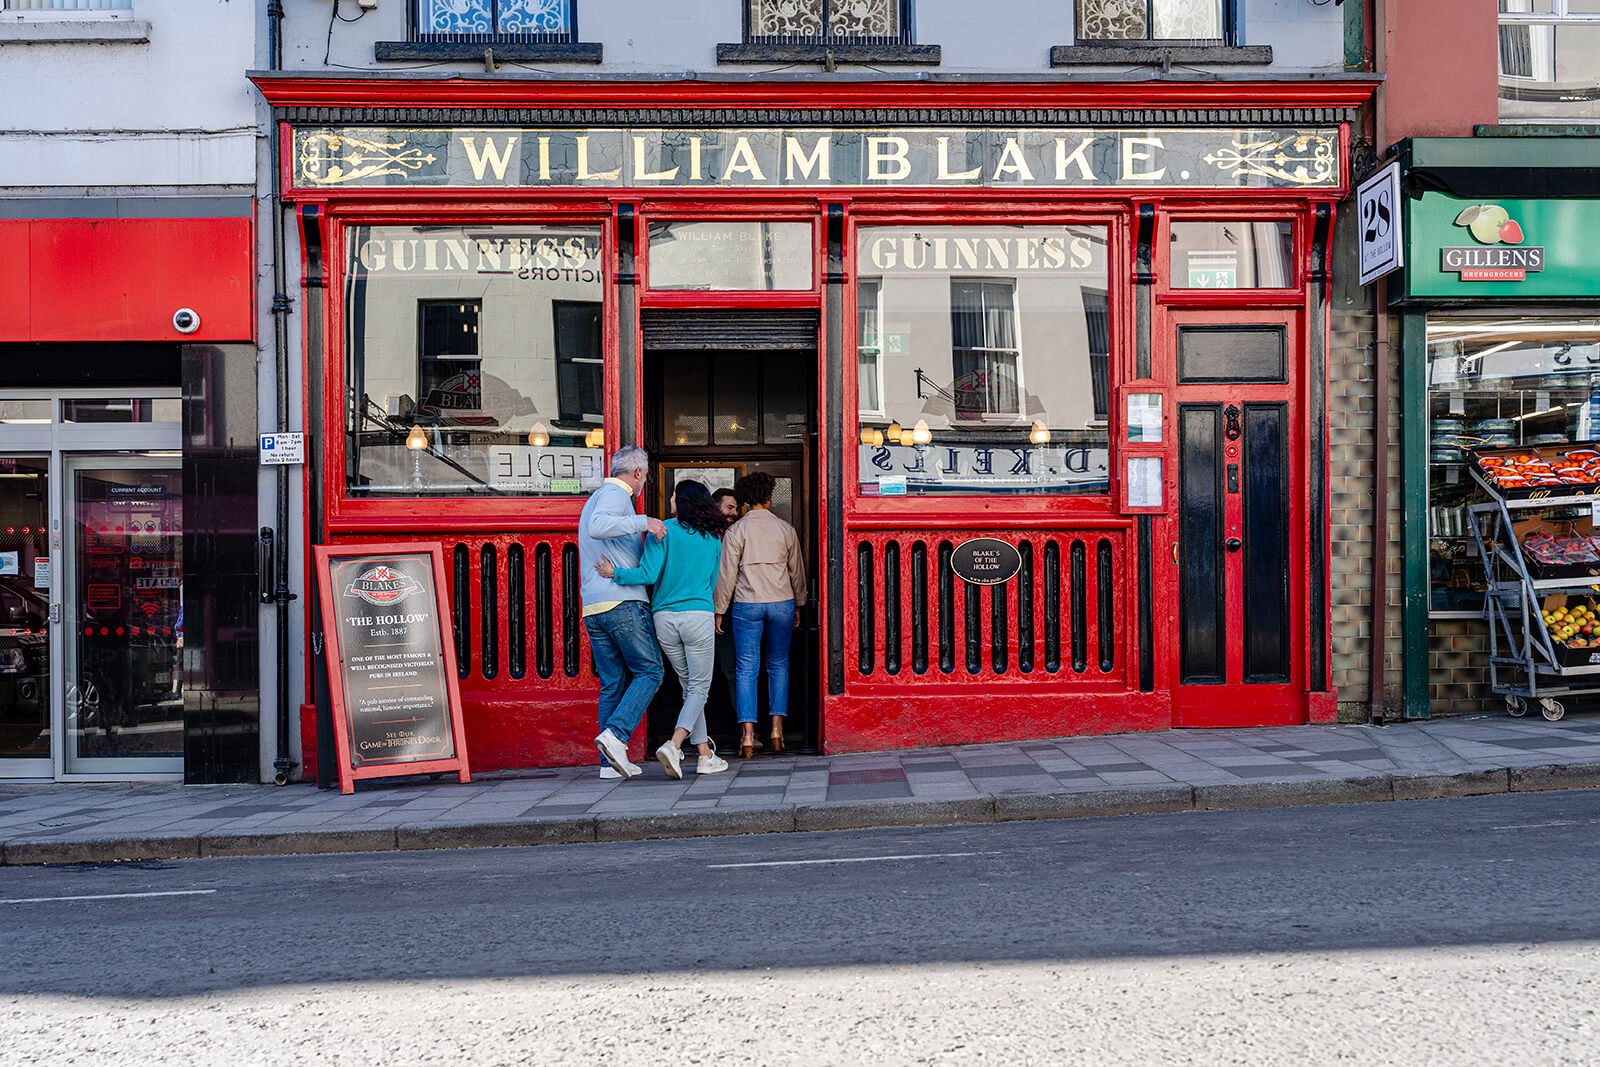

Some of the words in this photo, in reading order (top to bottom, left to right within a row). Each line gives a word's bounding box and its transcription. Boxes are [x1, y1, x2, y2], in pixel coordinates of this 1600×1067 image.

[460, 136, 831, 181] WILLIAM
[866, 136, 1191, 181] BLAKE.
[1364, 190, 1390, 242] 28
[677, 231, 733, 241] WILLIAM
[360, 236, 587, 271] GUINNESS
[871, 237, 1094, 270] GUINNESS
[1446, 249, 1540, 267] GILLENS
[265, 438, 273, 448] P
[362, 579, 407, 591] BLAKES
[370, 628, 390, 637] Estb.
[391, 627, 408, 635] 1887
[403, 660, 434, 668] VICTORIAN
[367, 698, 378, 706] pub
